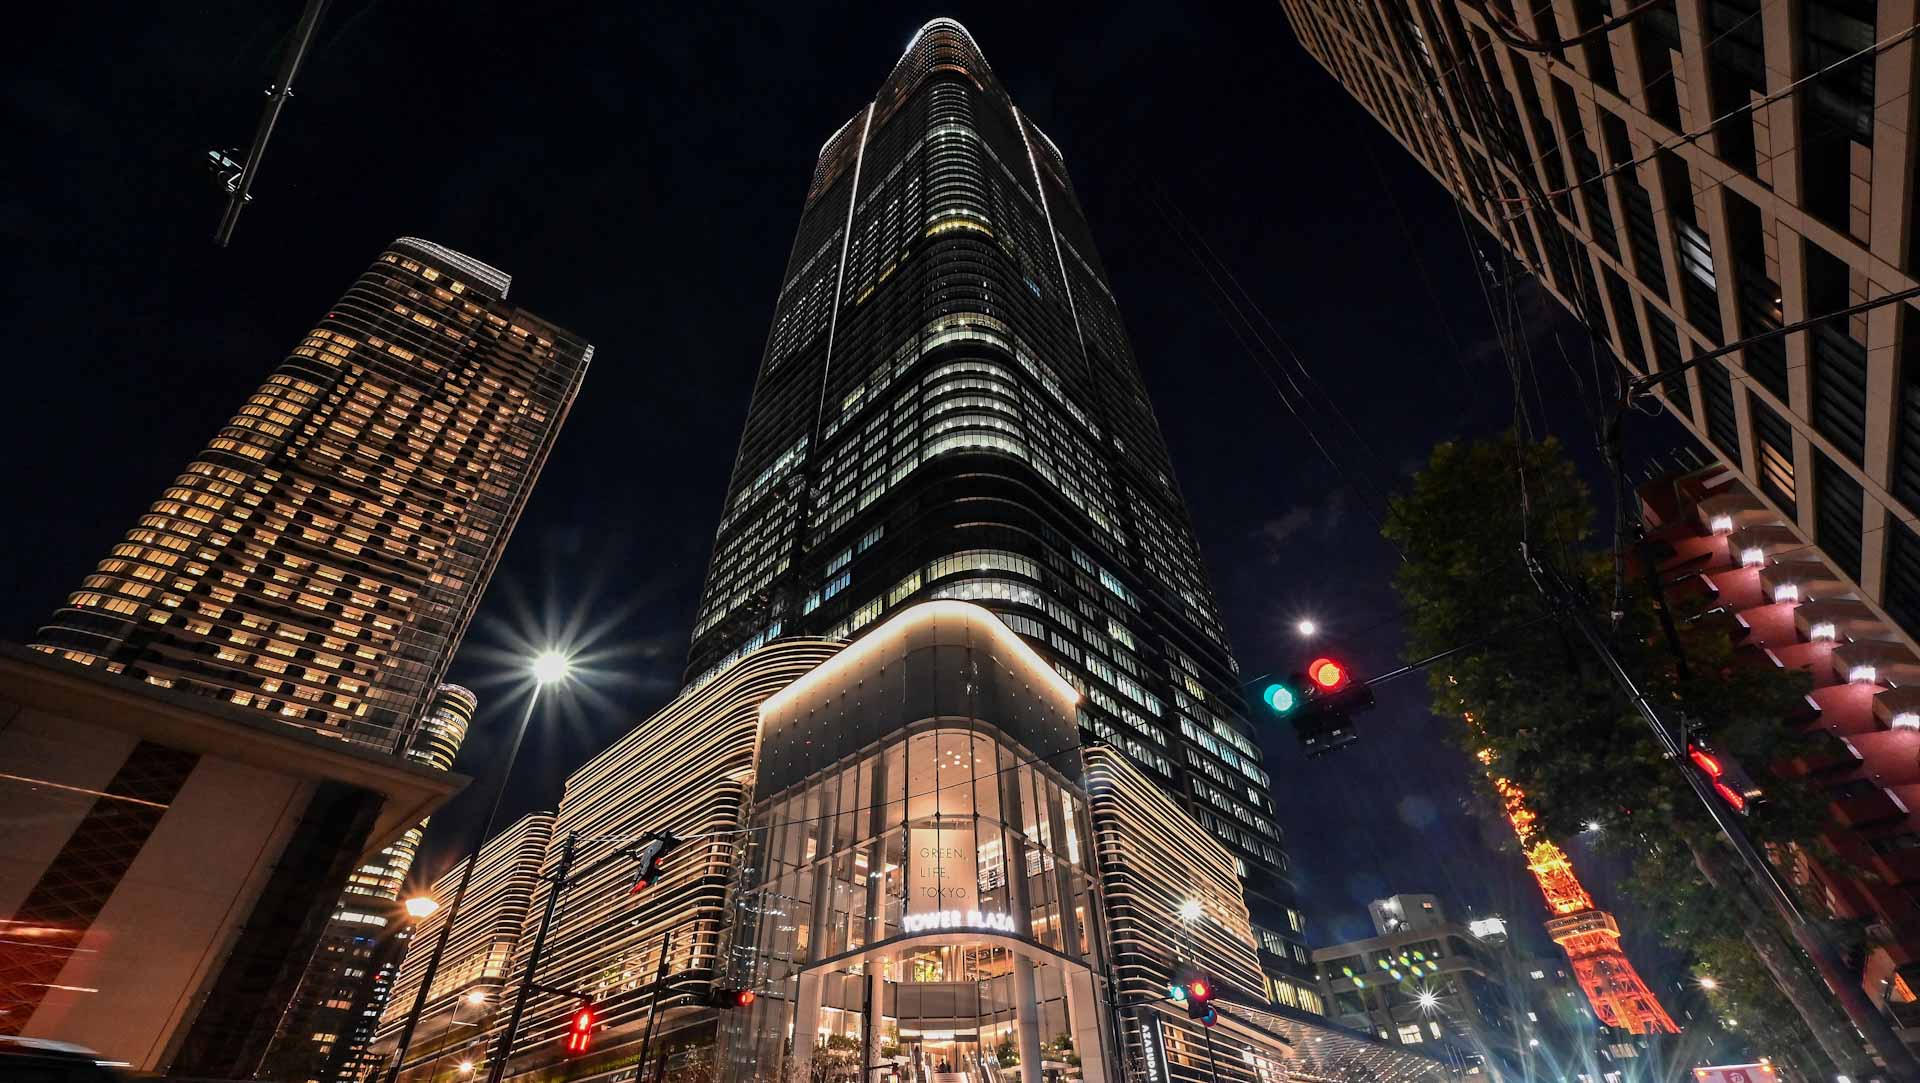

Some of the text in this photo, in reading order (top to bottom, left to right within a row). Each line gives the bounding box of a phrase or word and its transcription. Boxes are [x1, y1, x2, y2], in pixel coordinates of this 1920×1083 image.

[903, 911, 1015, 933] TOWER PLAZA
[1141, 1024, 1158, 1082] AZABUDAI
